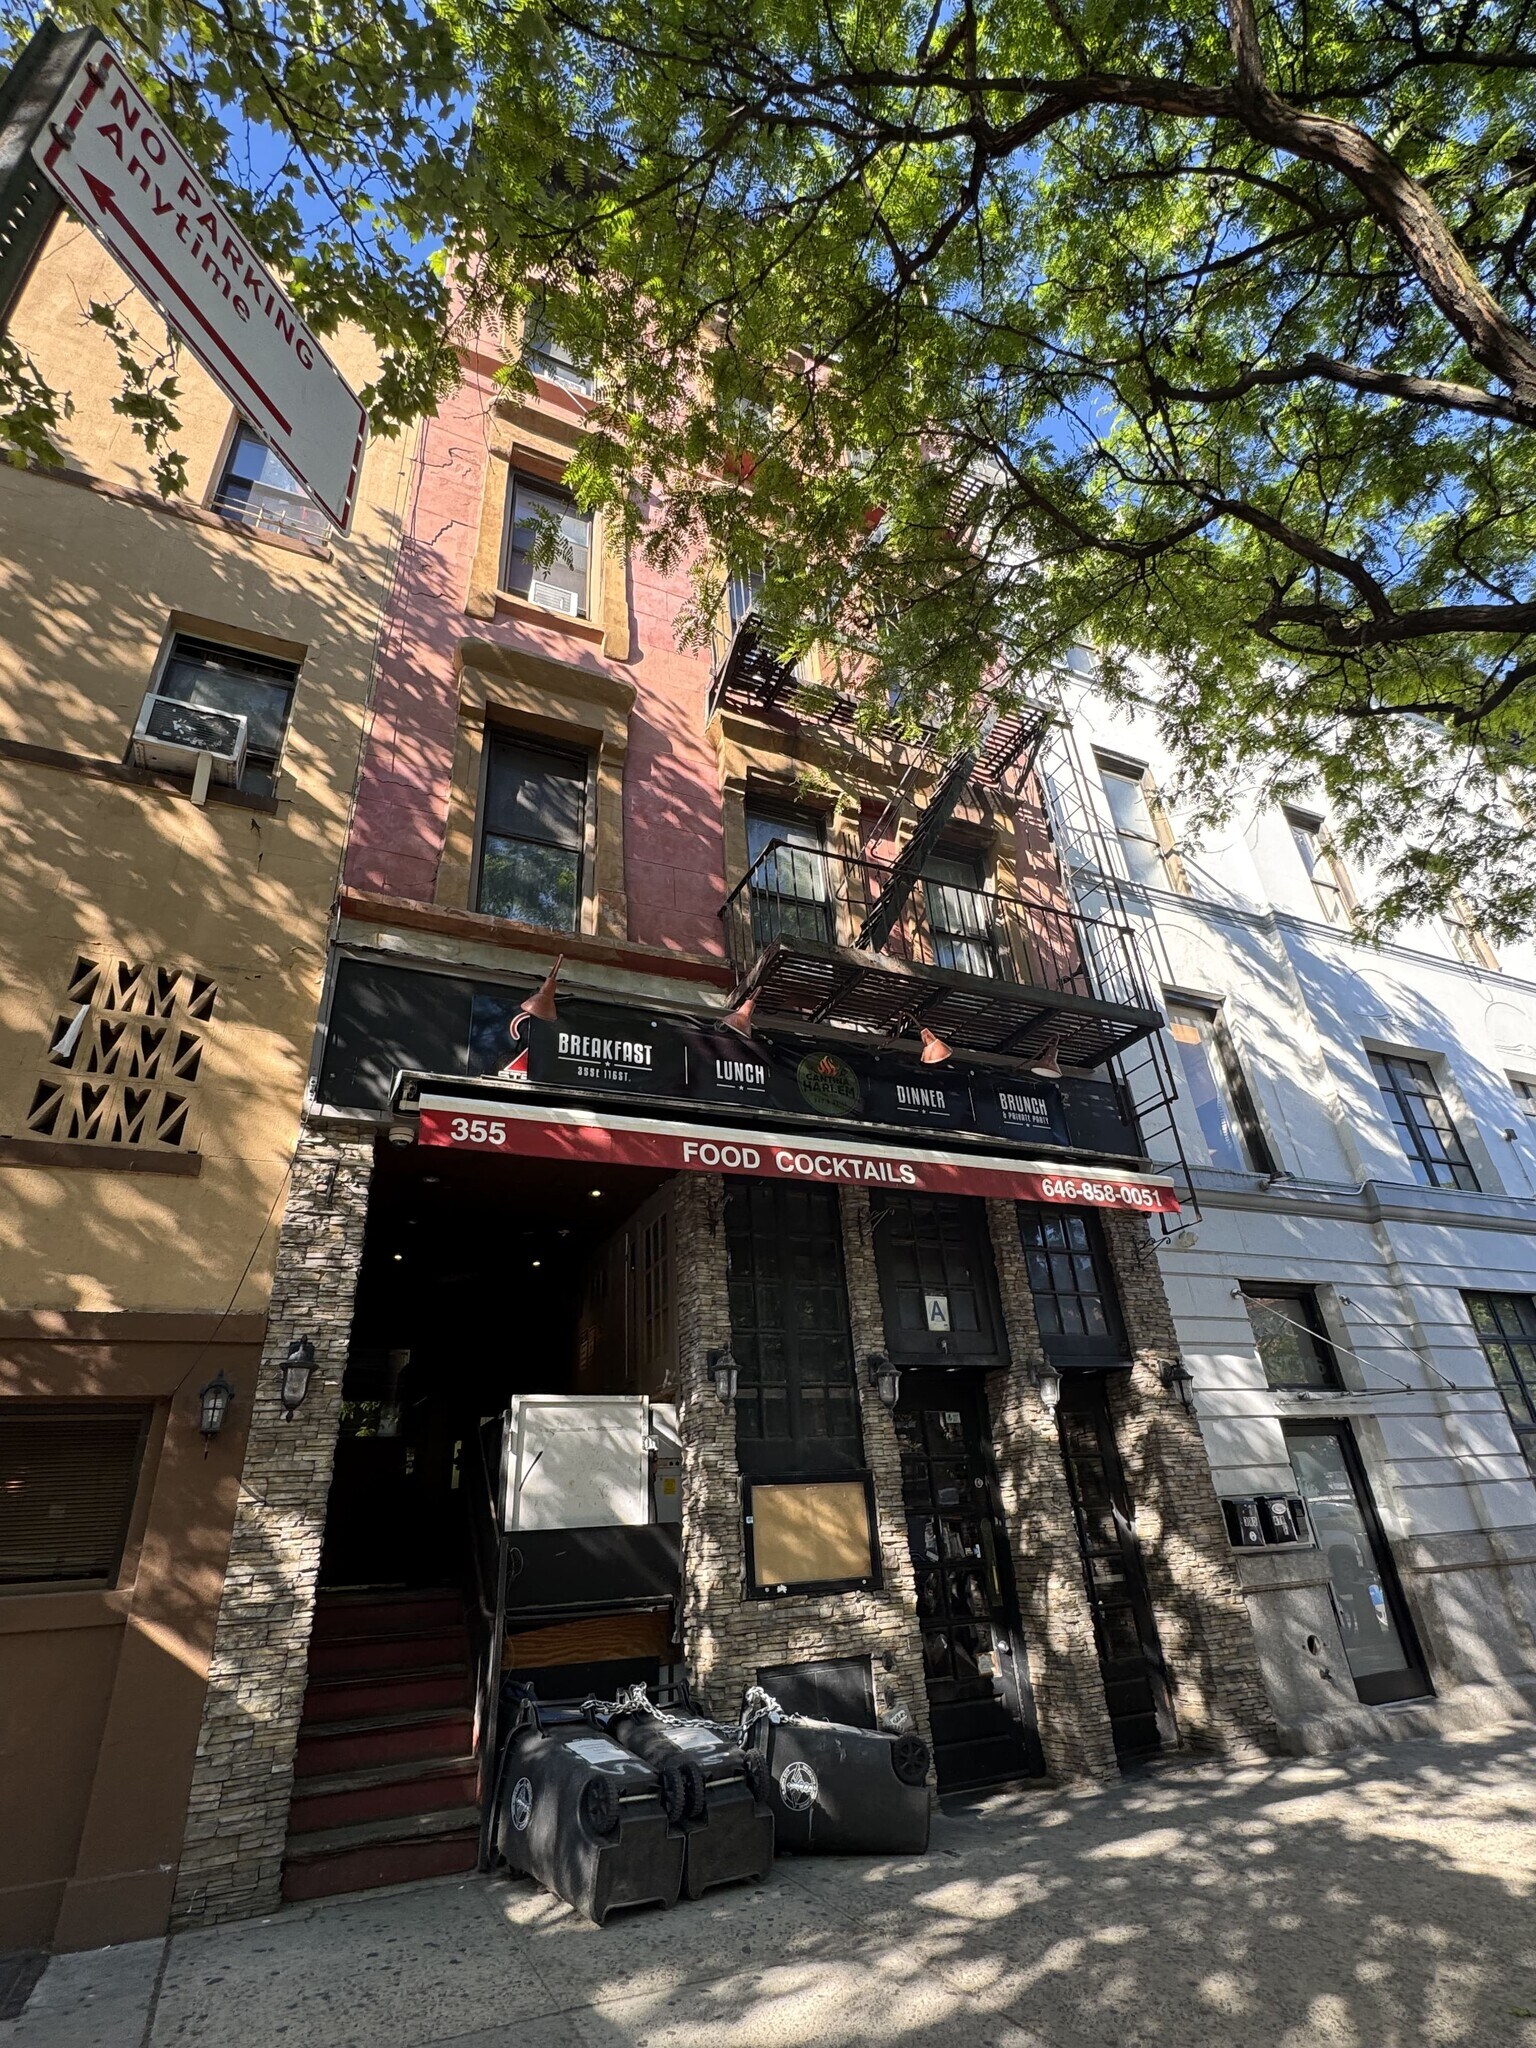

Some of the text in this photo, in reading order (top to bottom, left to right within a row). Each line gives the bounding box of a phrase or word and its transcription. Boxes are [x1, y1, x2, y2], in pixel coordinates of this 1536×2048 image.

[97, 123, 250, 324] Anytime
[110, 85, 315, 371] NO PARKING
[558, 1032, 653, 1065] BREAKFAST
[715, 1059, 765, 1085] LUNCH
[803, 1080, 855, 1099] HARLEM
[896, 1085, 946, 1109] DINNER
[999, 1092, 1048, 1116] BRUNCH
[450, 1117, 507, 1146] 355
[682, 1141, 916, 1184] FOOD COCKTAILS
[1041, 1177, 1163, 1208] 646-858-0051
[930, 1300, 946, 1321] A
